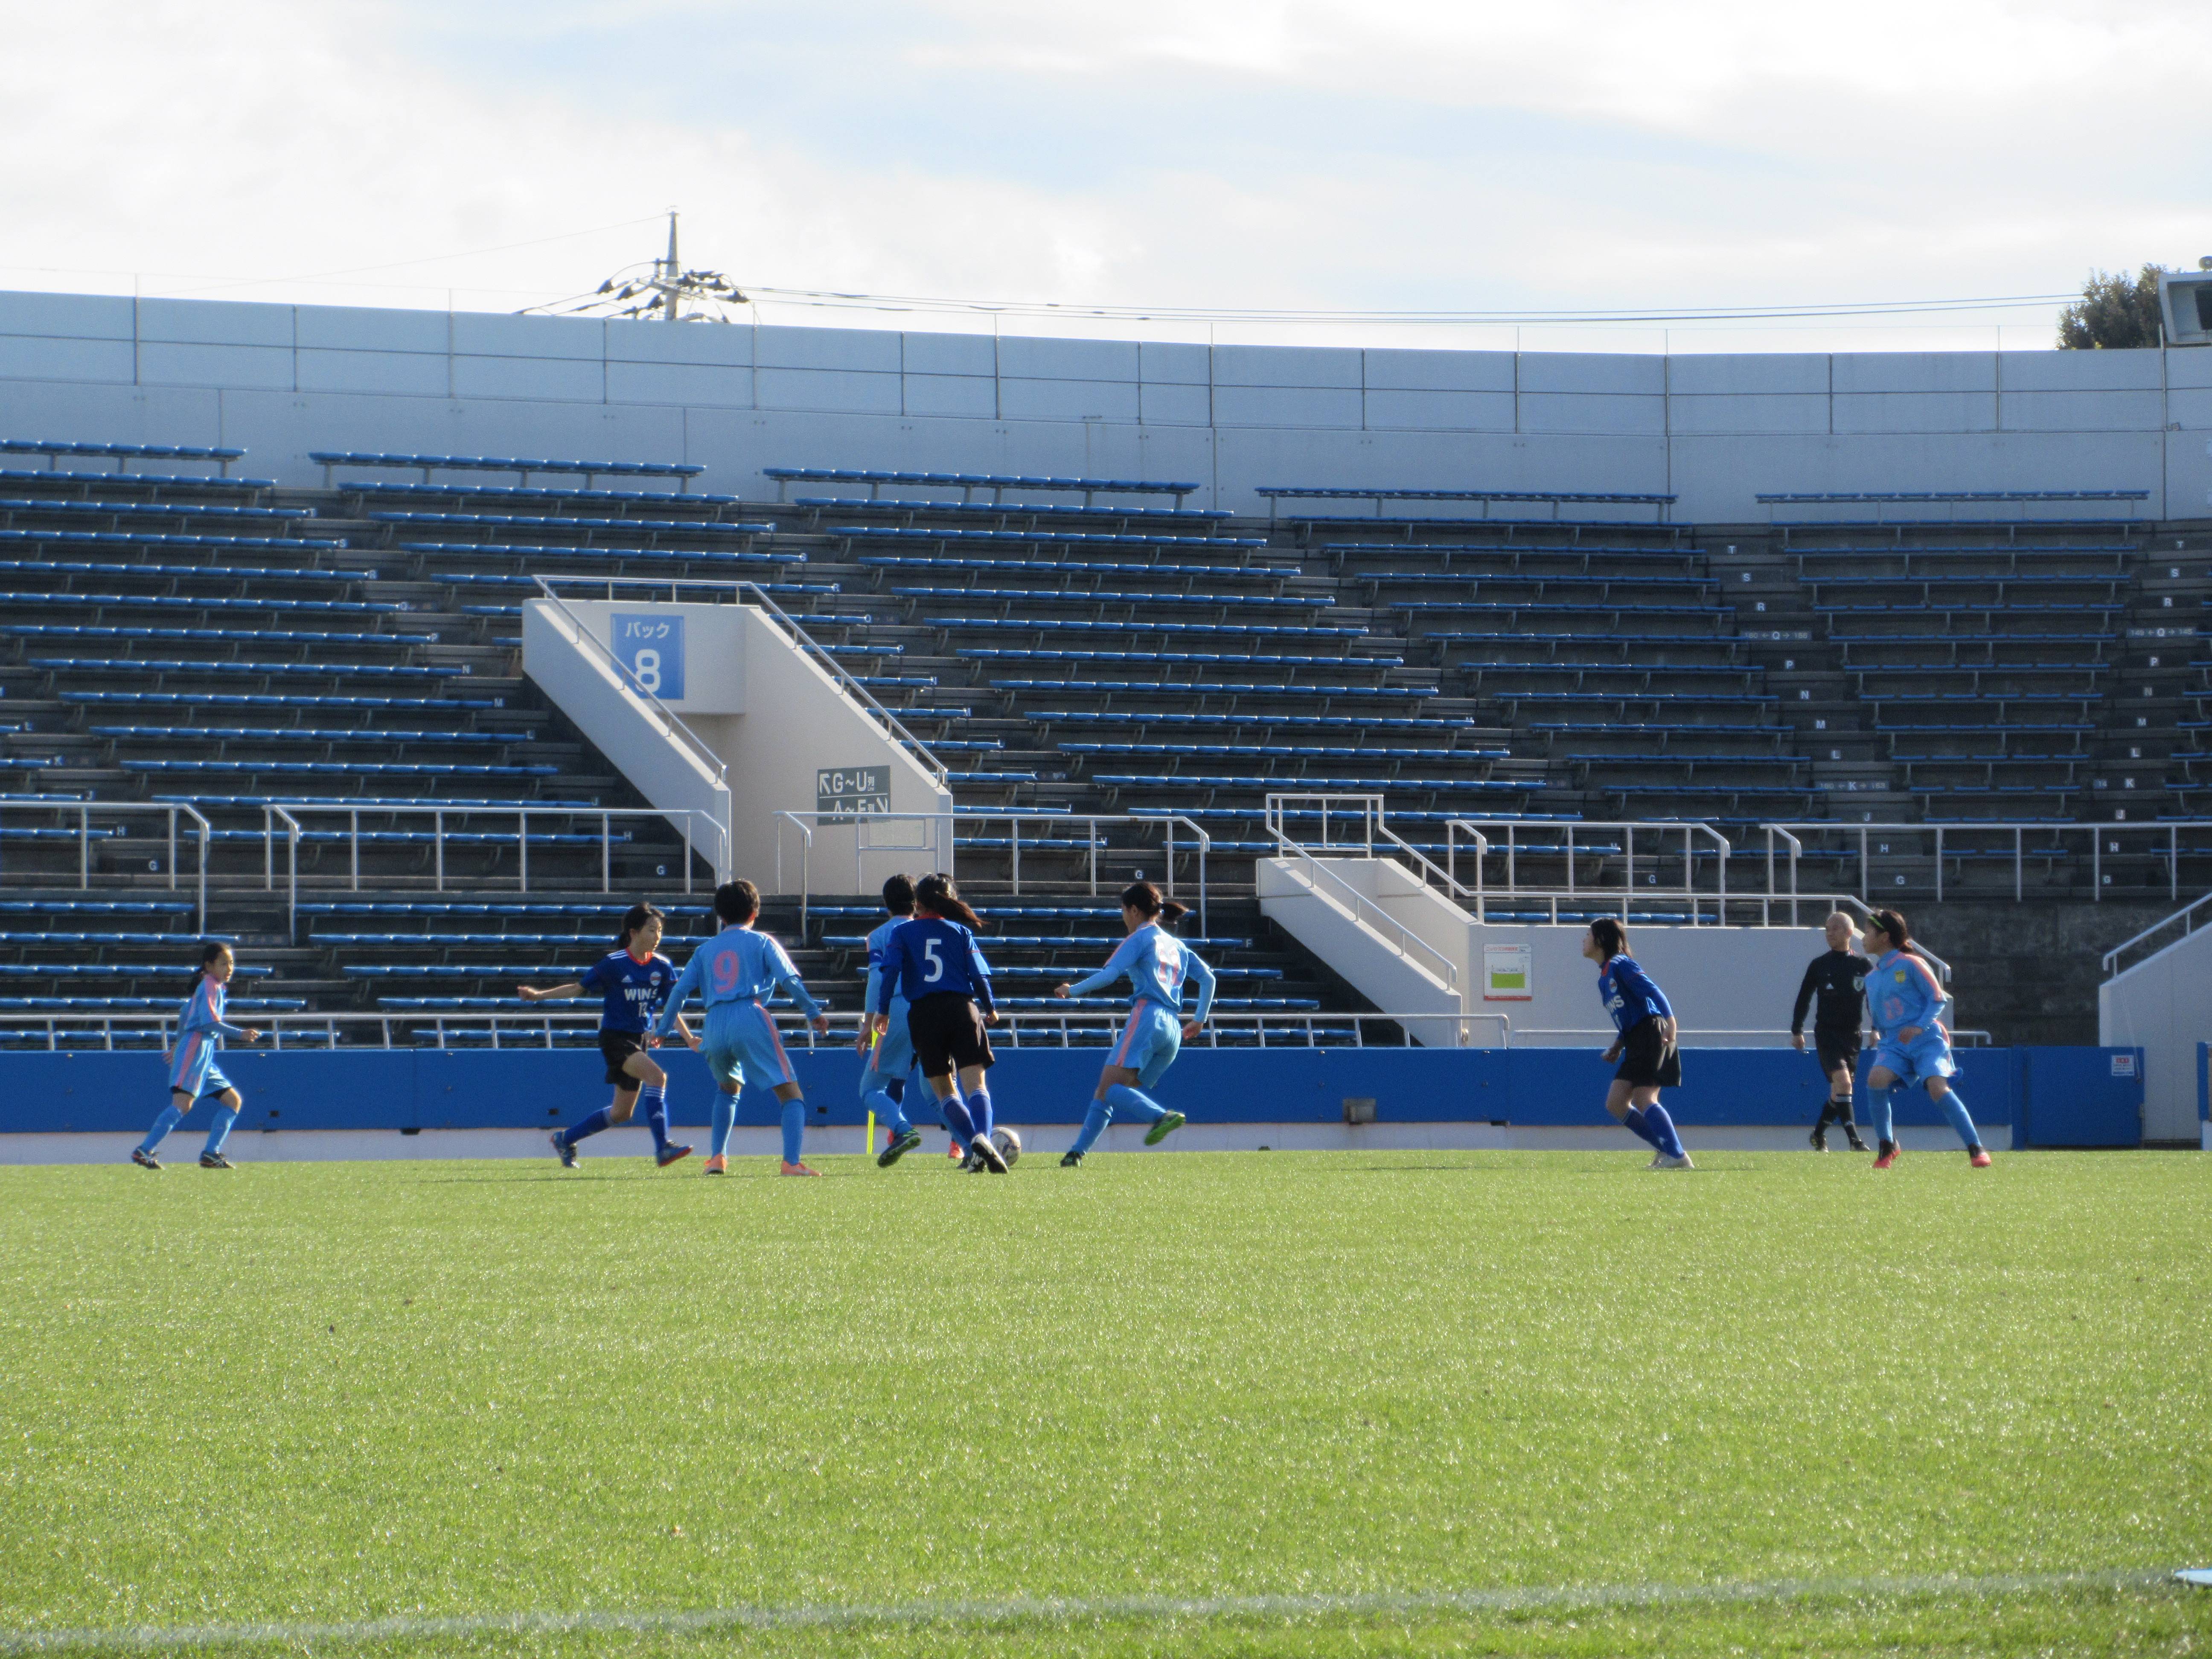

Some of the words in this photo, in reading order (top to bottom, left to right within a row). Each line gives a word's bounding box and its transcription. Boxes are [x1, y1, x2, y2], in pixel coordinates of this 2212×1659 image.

[768, 523, 775, 532] T
[2177, 541, 2184, 549] T
[1729, 546, 1736, 554] T
[2171, 568, 2179, 577] S
[1743, 573, 1751, 582] S
[833, 584, 840, 592] R
[1758, 602, 1765, 612] R
[2164, 598, 2172, 607] R
[625, 622, 669, 639] バック
[1773, 631, 1780, 640] Q
[1786, 661, 1793, 669] P
[2151, 658, 2158, 667] P
[463, 665, 471, 674] N
[635, 649, 661, 693] 8
[1801, 690, 1809, 699] N
[2144, 687, 2152, 696] N
[495, 699, 504, 707] M
[1816, 720, 1826, 729] M
[2138, 718, 2146, 726] M
[527, 731, 534, 739] L
[1833, 750, 1840, 759] L
[2132, 748, 2139, 758] L
[1848, 781, 1857, 790] K
[2125, 778, 2134, 788] K
[1864, 813, 1870, 821] J
[2117, 810, 2124, 819] J
[117, 827, 125, 836] H
[624, 832, 632, 841] H
[1881, 844, 1889, 853] H
[2110, 843, 2119, 852] H
[149, 861, 158, 871] G
[656, 866, 665, 875] G
[1135, 870, 1144, 879] G
[1648, 875, 1656, 884] G
[1896, 876, 1905, 885] G
[1246, 939, 1252, 948] F
[924, 938, 943, 982] 5
[714, 950, 739, 994] 9
[624, 988, 657, 1001] WINS
